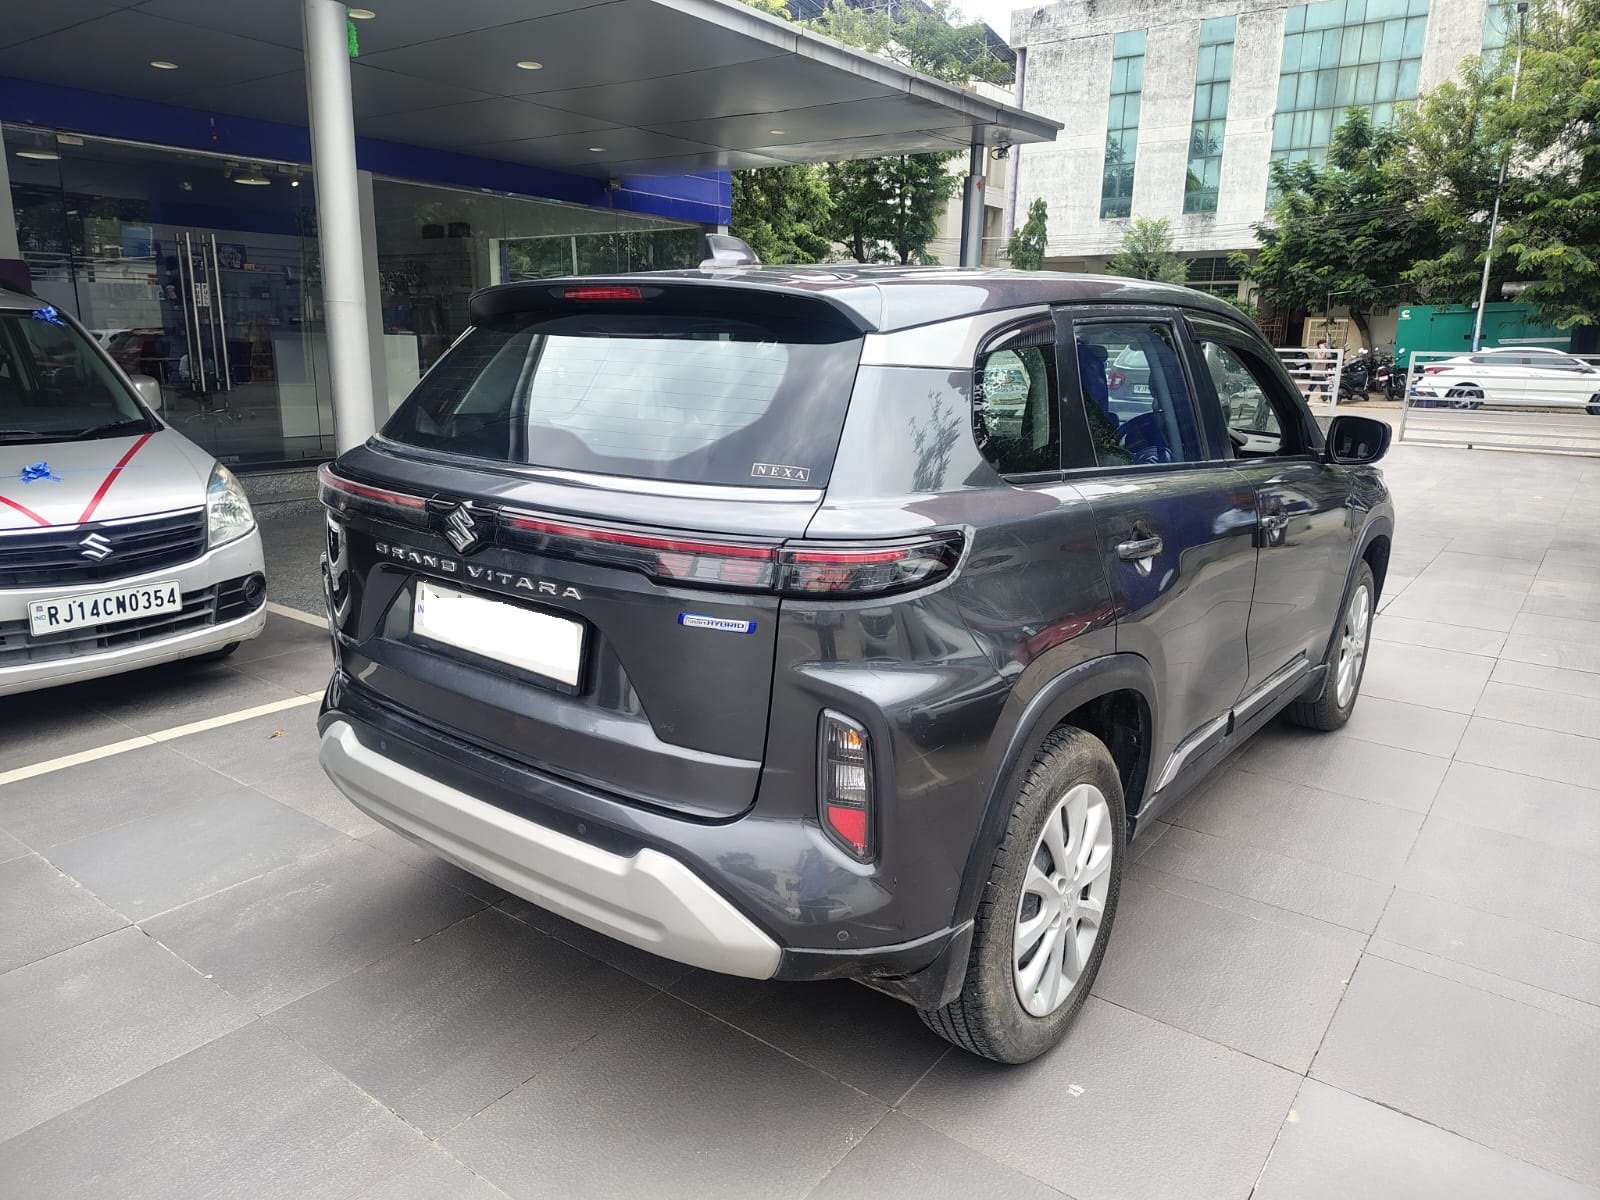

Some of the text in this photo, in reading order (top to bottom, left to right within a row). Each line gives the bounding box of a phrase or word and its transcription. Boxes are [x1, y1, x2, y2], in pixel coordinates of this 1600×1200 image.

[757, 465, 805, 480] NEXA
[376, 542, 583, 600] GRAND VITARA
[47, 587, 176, 626] RJ14CN0354
[706, 619, 745, 629] HYBRID
